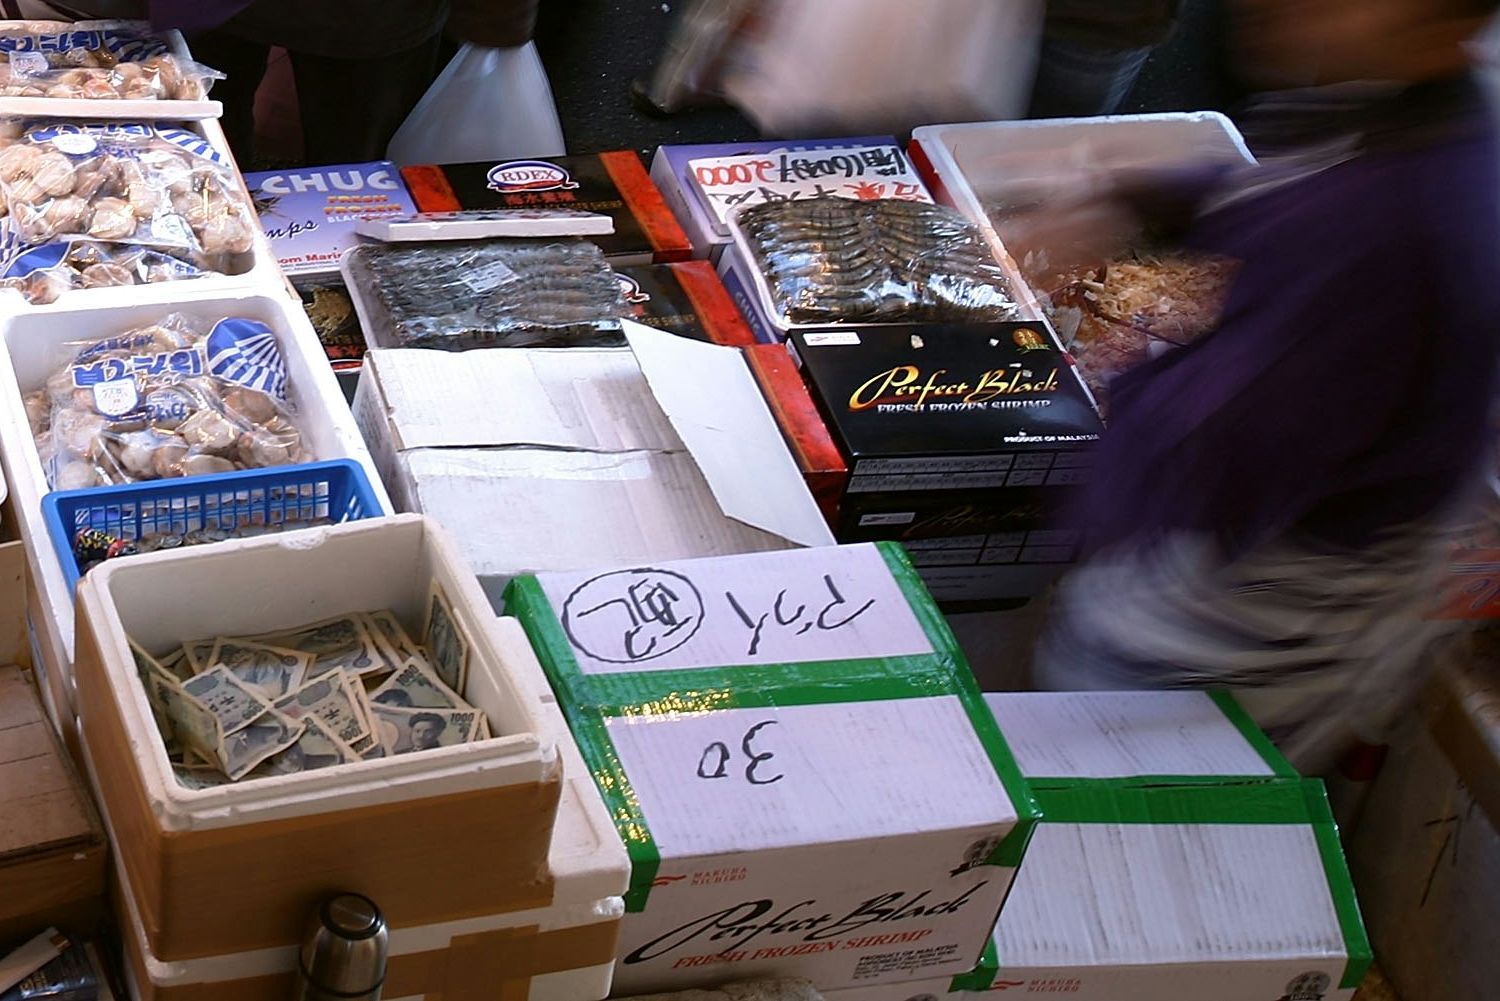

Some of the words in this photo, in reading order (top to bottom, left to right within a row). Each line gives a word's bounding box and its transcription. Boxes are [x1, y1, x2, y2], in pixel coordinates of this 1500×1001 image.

[261, 170, 399, 194] CHUG
[326, 194, 388, 204] FRESH
[323, 204, 403, 216] FROZEN
[848, 365, 970, 411] Perfect
[963, 367, 1060, 403] Black
[929, 402, 988, 412] FROZEN
[990, 400, 1052, 410] SHRIMP
[1003, 435, 1043, 443] PRODUCT
[450, 712, 475, 722] 1000
[696, 720, 785, 786] 30
[623, 899, 832, 964] Perfect
[803, 881, 988, 941] Black
[671, 950, 745, 969] FRESH
[752, 939, 839, 960] FROZEN
[841, 928, 934, 951] SHRIMP
